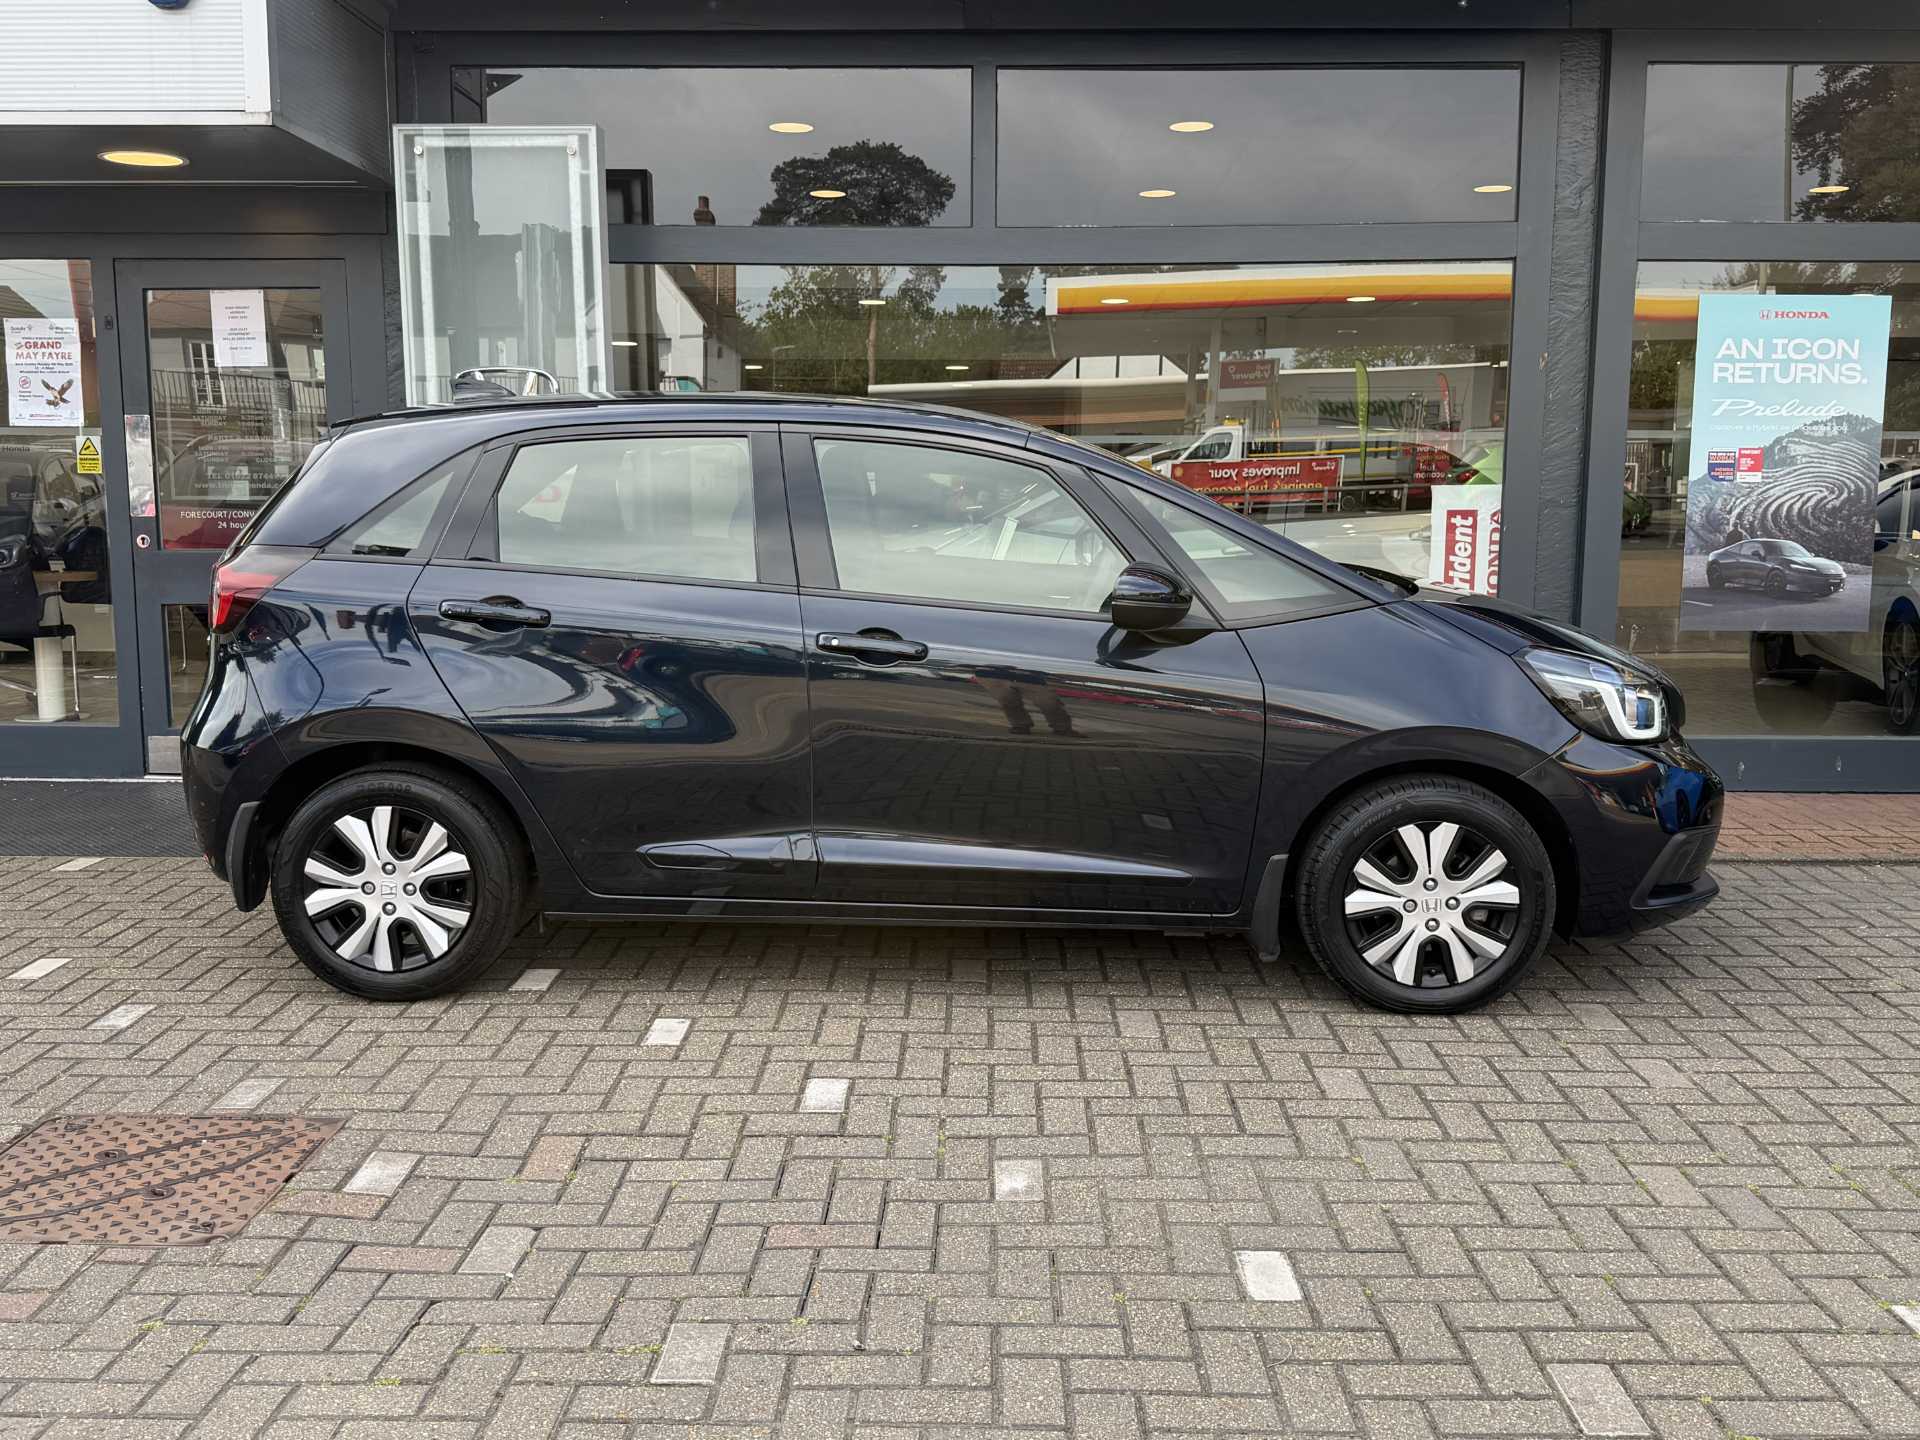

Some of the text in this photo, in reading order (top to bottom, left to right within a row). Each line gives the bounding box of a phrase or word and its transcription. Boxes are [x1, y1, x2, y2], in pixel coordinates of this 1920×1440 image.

[1774, 310, 1830, 319] HONDA
[24, 341, 62, 350] GRAND
[1715, 337, 1860, 360] AN ICON
[15, 352, 73, 360] MAY FAYRE
[1712, 362, 1869, 384] RETURNS.
[1711, 398, 1848, 417] Prelude
[180, 511, 255, 519] FORECOURT/CONV
[217, 521, 227, 529] 24
[1449, 515, 1474, 591] rident
